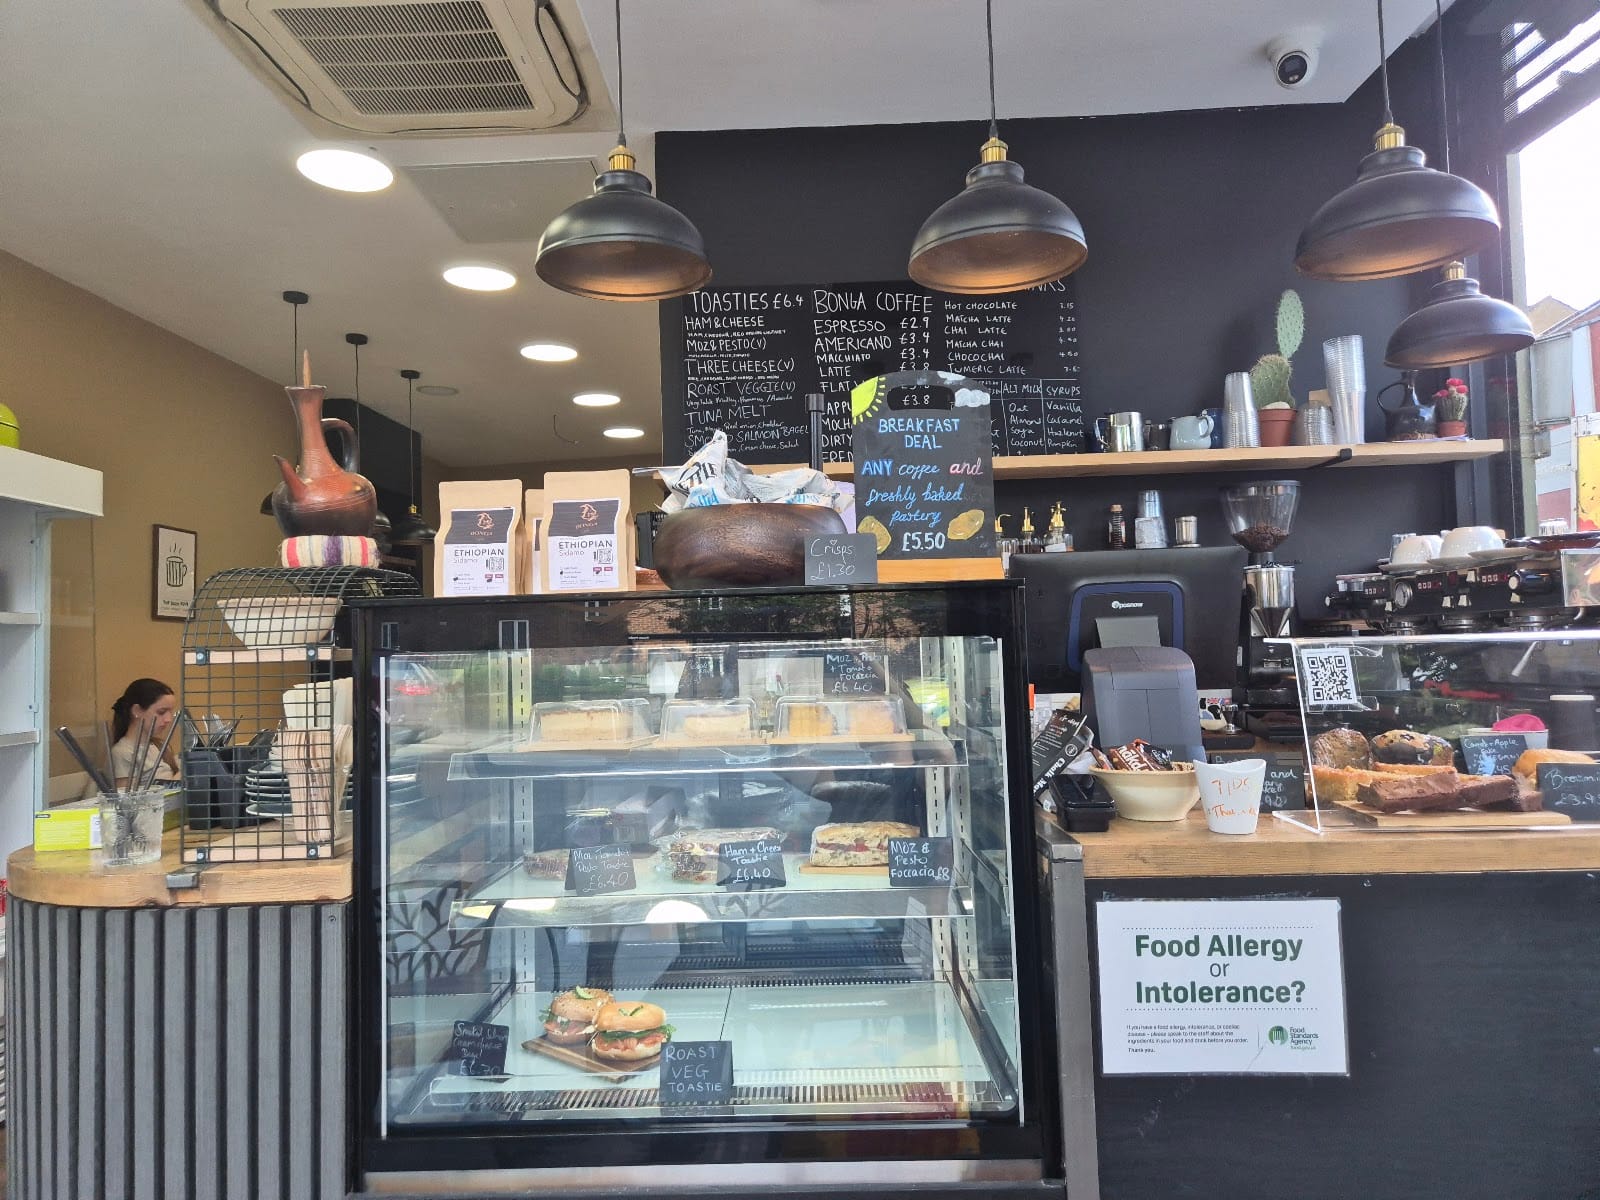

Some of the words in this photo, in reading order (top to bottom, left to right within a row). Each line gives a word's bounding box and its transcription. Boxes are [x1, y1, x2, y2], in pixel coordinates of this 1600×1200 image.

[687, 290, 769, 314] TOASTIES
[772, 292, 804, 309] £6.4
[813, 289, 867, 314] BONGA
[876, 291, 934, 314] COFFEE
[965, 300, 1019, 311] CHOCOLATE
[813, 319, 887, 336] ESPRESSO
[899, 316, 931, 330] £2.9
[946, 313, 980, 324] MATCHA
[986, 314, 1013, 324] LATTE
[944, 325, 969, 336] CHAI
[978, 326, 1008, 336] LATTE
[814, 335, 893, 354] AMERICANO
[898, 331, 931, 346] £3.4
[946, 339, 979, 350] MATCHA
[981, 339, 1005, 349] CHAI
[815, 353, 872, 365] MACCHIATO
[899, 346, 931, 361] £3.4
[684, 359, 730, 375] THREE
[819, 366, 852, 379] LATTE
[998, 364, 1027, 376] LATTE
[687, 382, 732, 400] ROAST
[820, 380, 850, 392] FLAT
[1045, 385, 1081, 397] SYRUPS
[684, 407, 723, 426] TUNA
[728, 404, 773, 420] MELT
[1008, 402, 1030, 413] Oat
[1045, 401, 1082, 414] Vanilla
[821, 416, 854, 433] MOCH
[878, 417, 961, 433] BREAKFAST
[735, 428, 780, 443] SALMON
[904, 434, 943, 450] DEAL
[1010, 437, 1043, 448] Coconut
[861, 458, 895, 476] ANY
[898, 464, 942, 481] coffee
[949, 456, 984, 475] and
[865, 485, 918, 510] freshly
[921, 481, 966, 502] baked
[558, 540, 613, 550] ETHIOPIAN
[901, 531, 947, 552] £5.50
[453, 548, 505, 558] ETHIOPIAN
[810, 537, 854, 567] Crisps
[810, 562, 856, 583] £1.30
[831, 681, 873, 695] £6.40
[1494, 738, 1519, 749] Apple
[1044, 757, 1066, 779] Chalk
[1270, 768, 1299, 779] and
[1544, 768, 1600, 790] Browni
[724, 844, 748, 858] Ham
[730, 853, 769, 866] Toastie
[894, 854, 928, 867] Pesto
[732, 867, 771, 884] £6.40
[1134, 934, 1201, 958] Food
[1206, 934, 1304, 963] Allergy
[1209, 962, 1231, 979] or
[1135, 980, 1306, 1004] Intolerance?
[1289, 1026, 1305, 1034] Food
[1289, 1032, 1319, 1041] Standards
[1290, 1039, 1313, 1047] Agency
[665, 1045, 719, 1063] ROAST
[671, 1063, 710, 1080] VEG
[666, 1081, 723, 1094] TOASTIE
